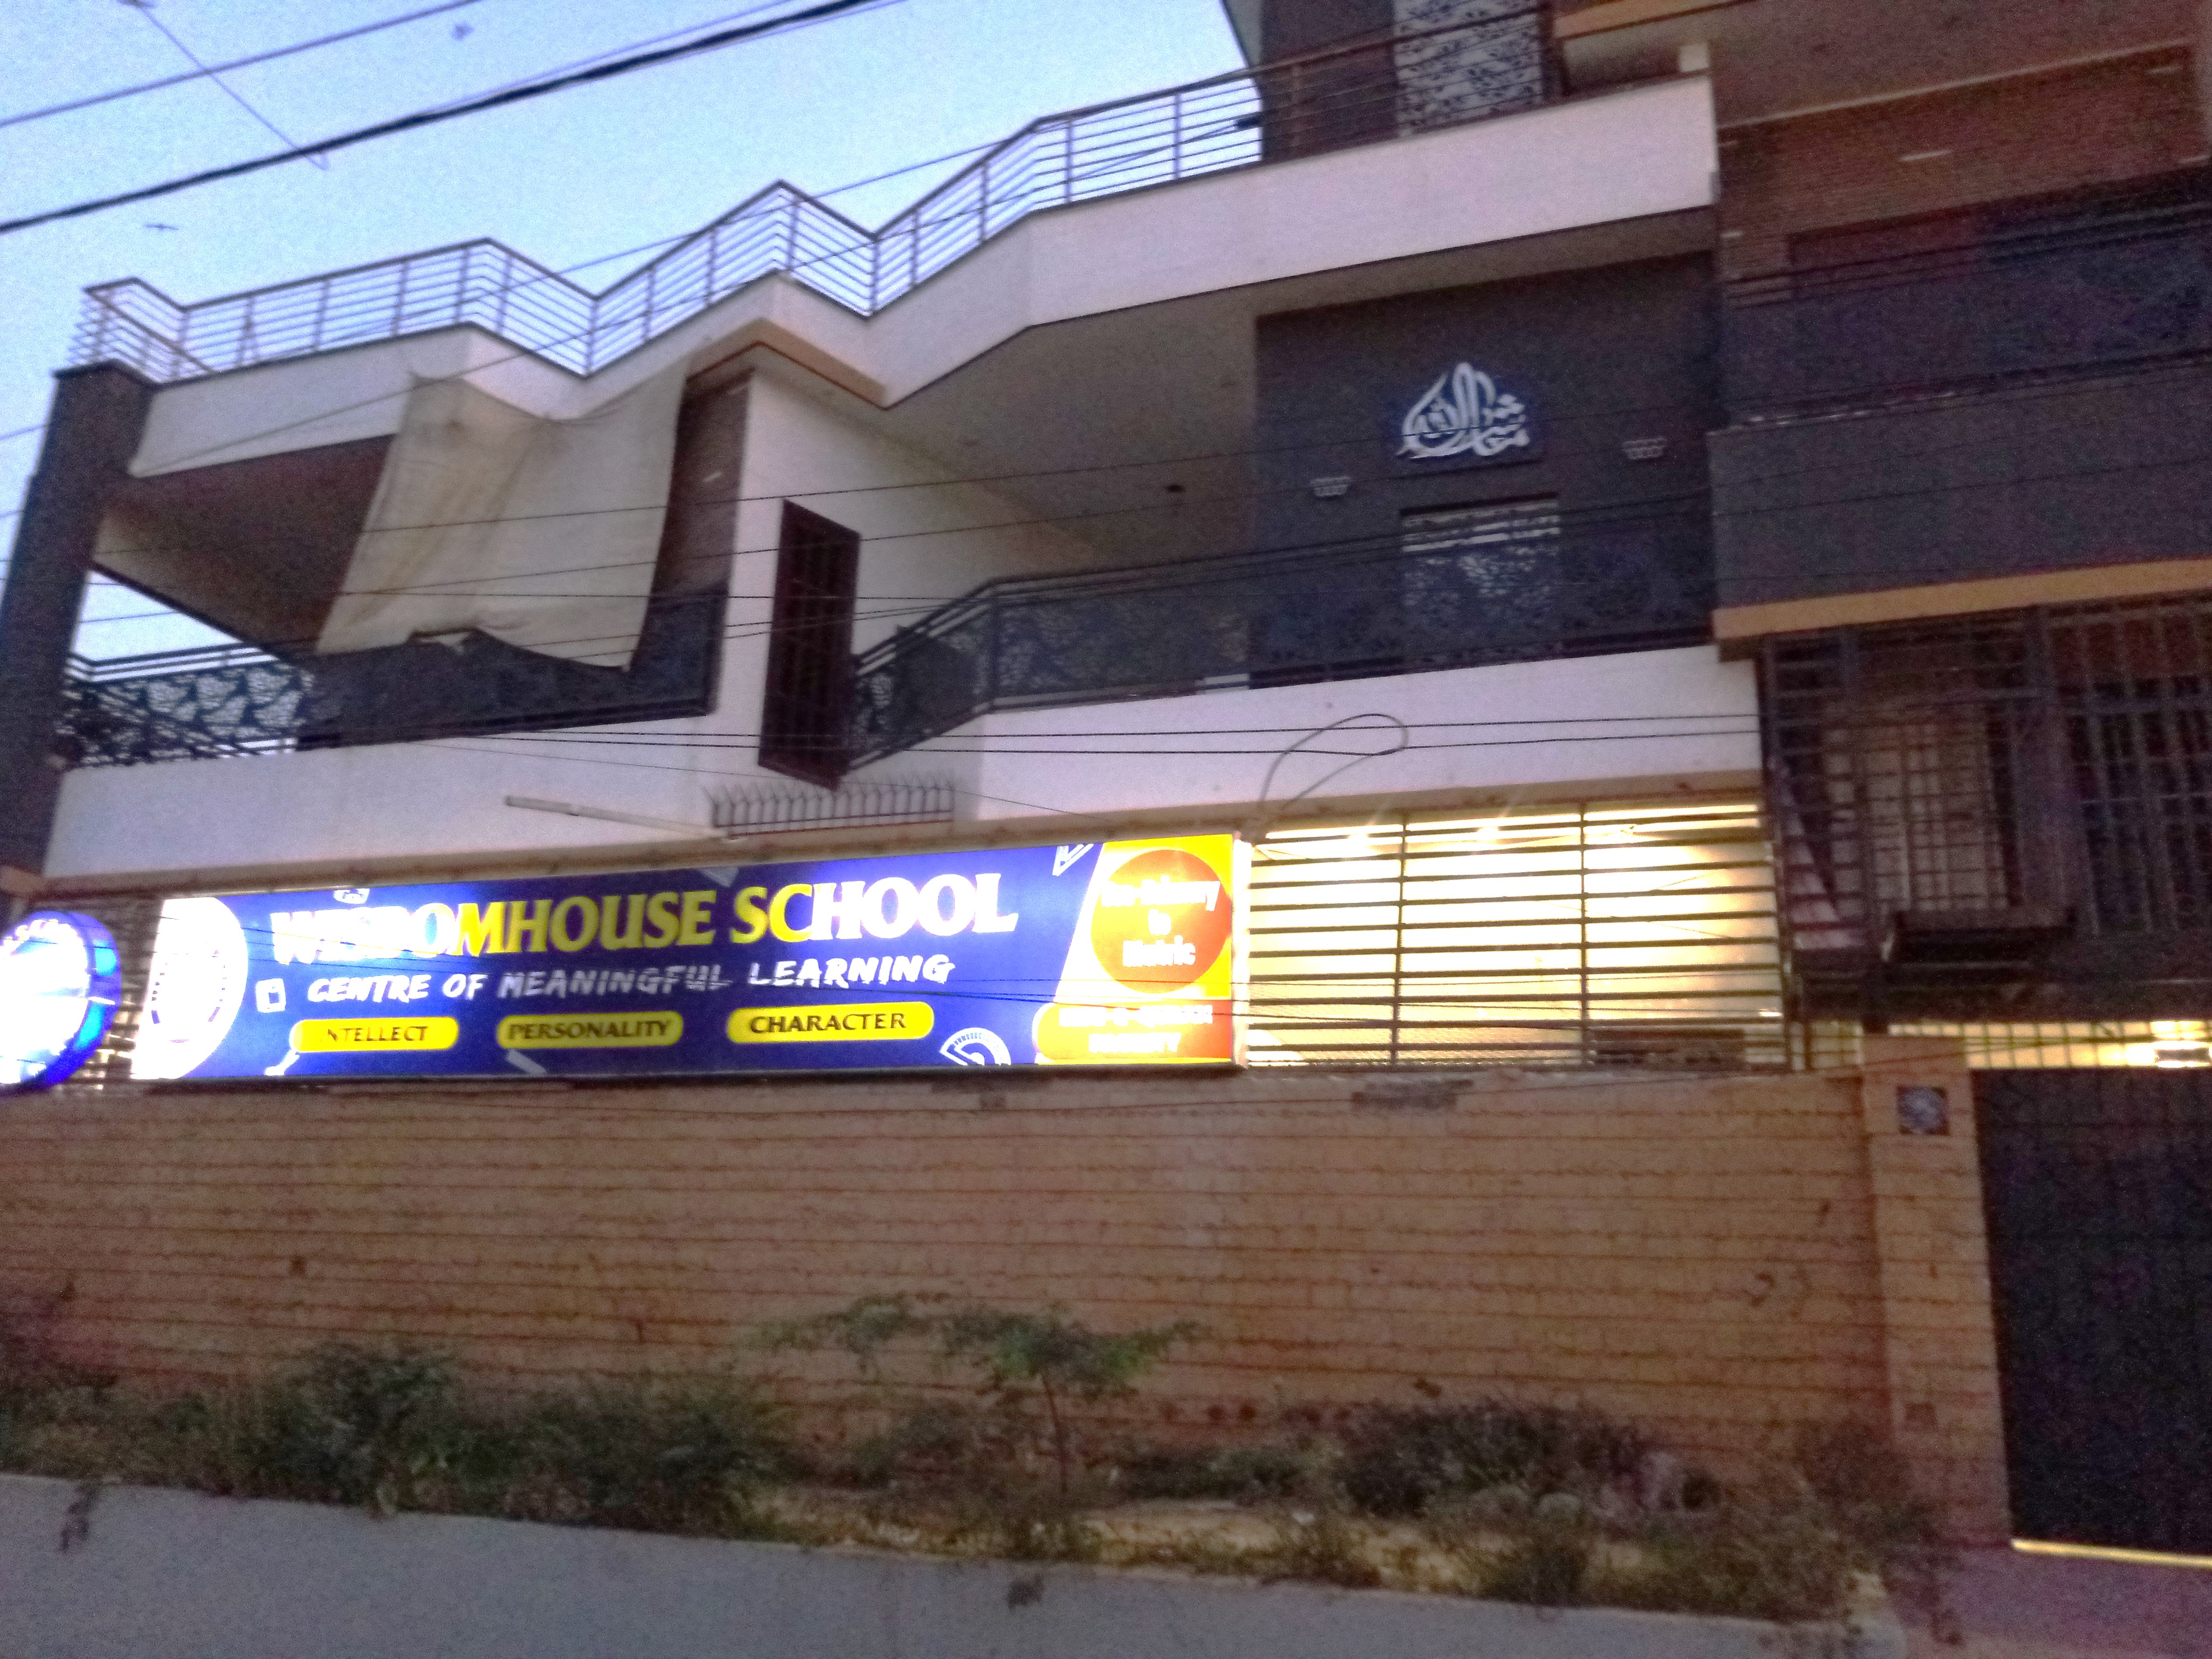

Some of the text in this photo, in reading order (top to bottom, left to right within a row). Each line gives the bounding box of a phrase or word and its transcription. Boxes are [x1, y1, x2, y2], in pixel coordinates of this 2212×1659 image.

[730, 874, 1018, 944] SCHOOL
[307, 954, 955, 1003] CENTRE OF MEANINGFUL LEARNING
[320, 1025, 429, 1043] NTELLECT
[508, 1020, 671, 1040] PERSONALITY
[750, 1012, 907, 1034] CHARACTER
